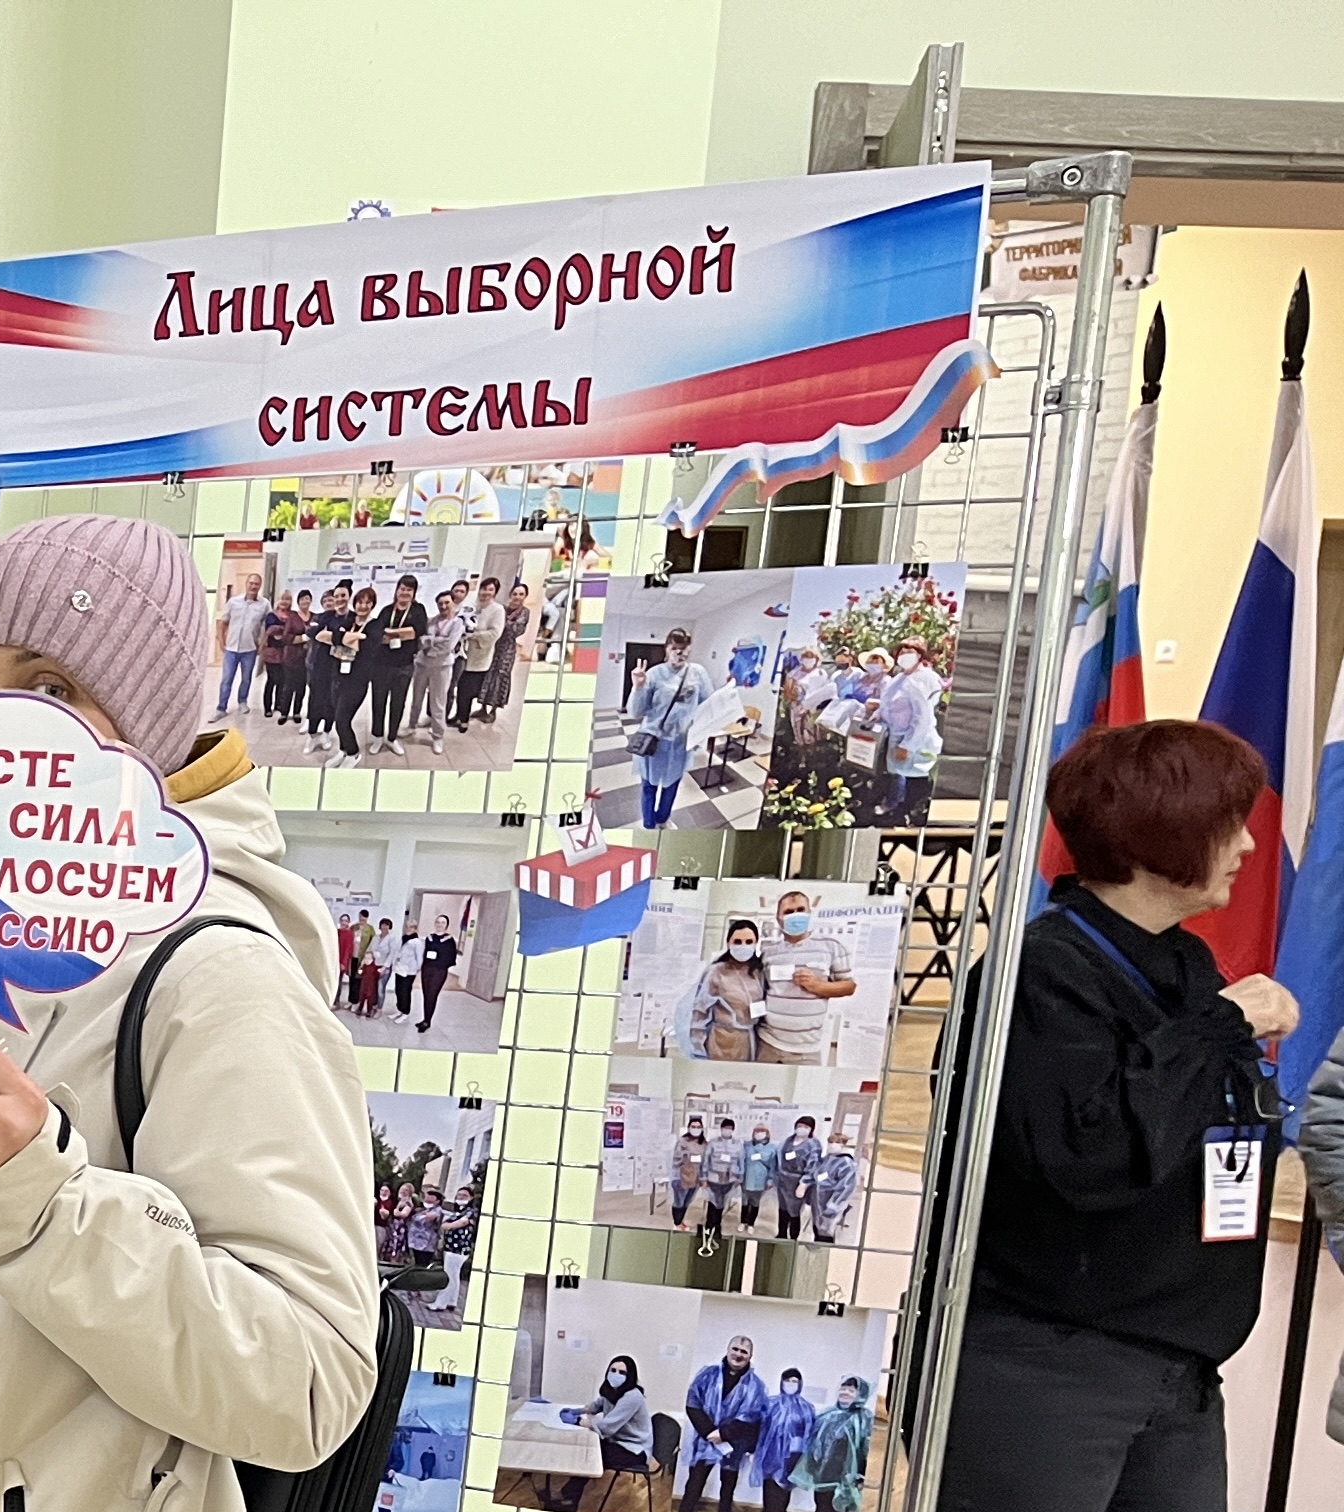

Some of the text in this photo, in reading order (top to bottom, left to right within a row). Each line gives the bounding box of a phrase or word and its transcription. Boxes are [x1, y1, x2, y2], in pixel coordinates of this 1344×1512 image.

[1005, 238, 1083, 262] ТЕРРИТОРИ
[153, 225, 737, 345] Лица выборной
[257, 377, 593, 447] системы
[9, 802, 137, 846] СИЛА
